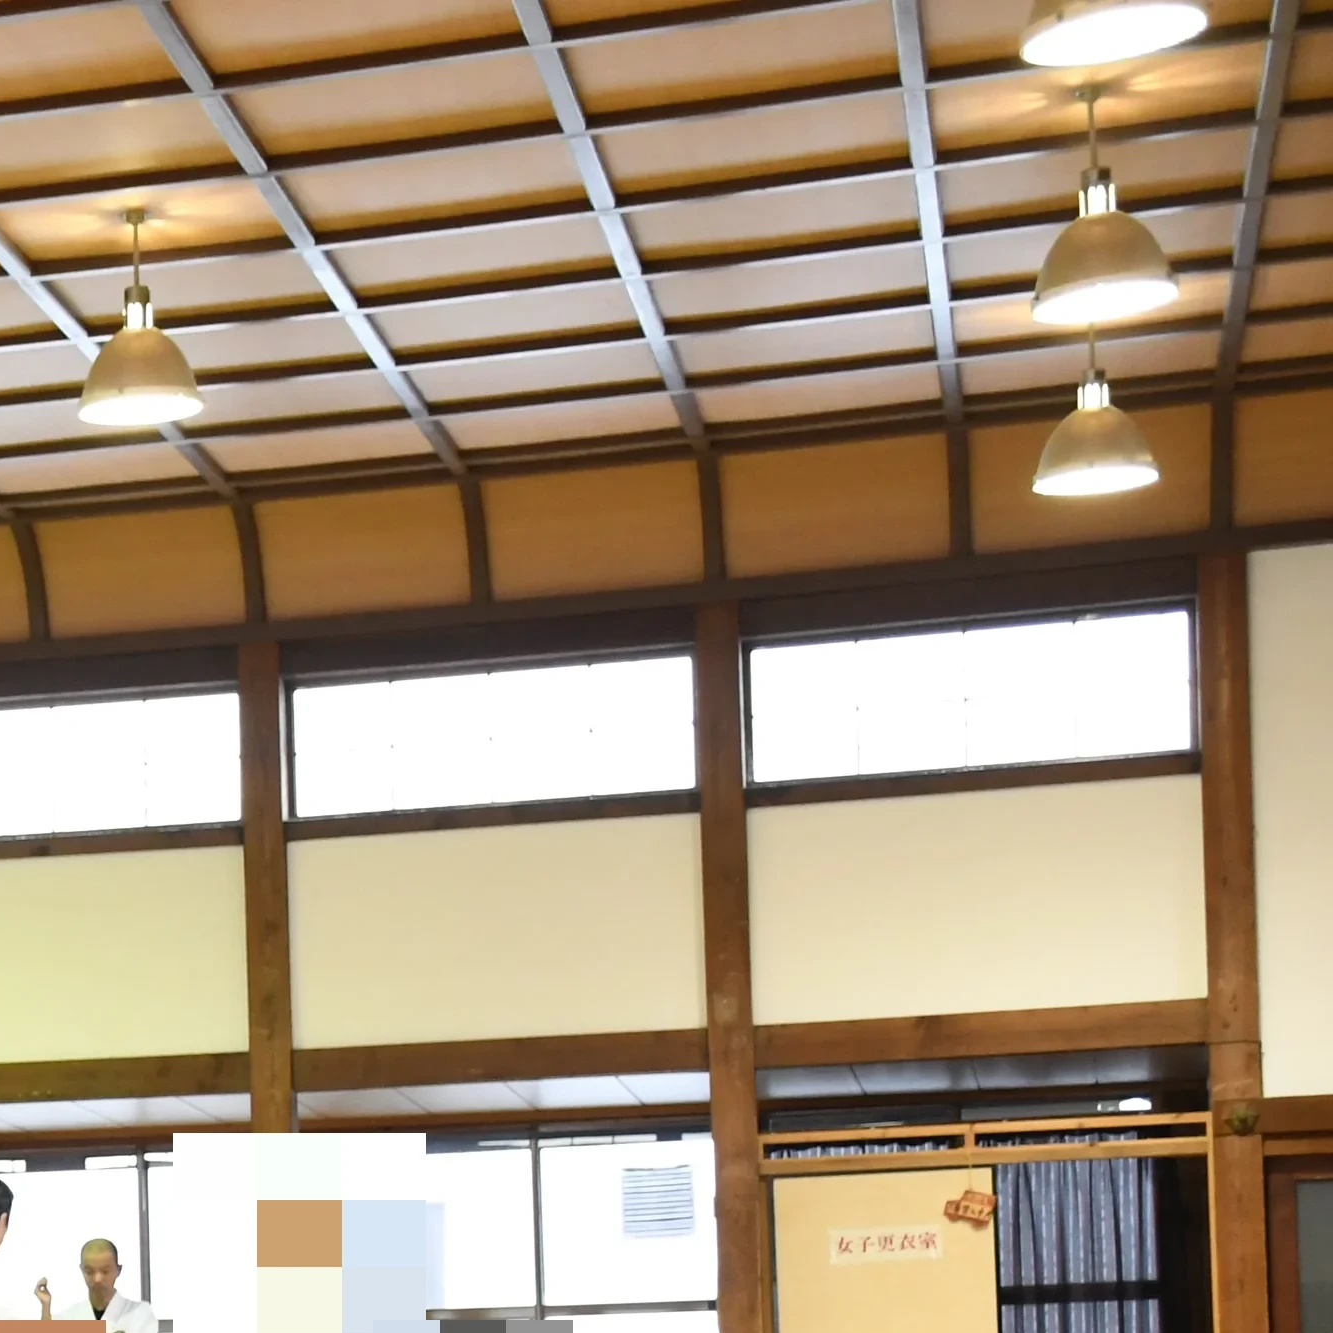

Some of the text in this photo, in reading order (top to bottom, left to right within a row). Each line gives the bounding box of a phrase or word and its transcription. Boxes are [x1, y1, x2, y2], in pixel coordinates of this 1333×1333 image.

[837, 1231, 937, 1255] 女子更衣室
